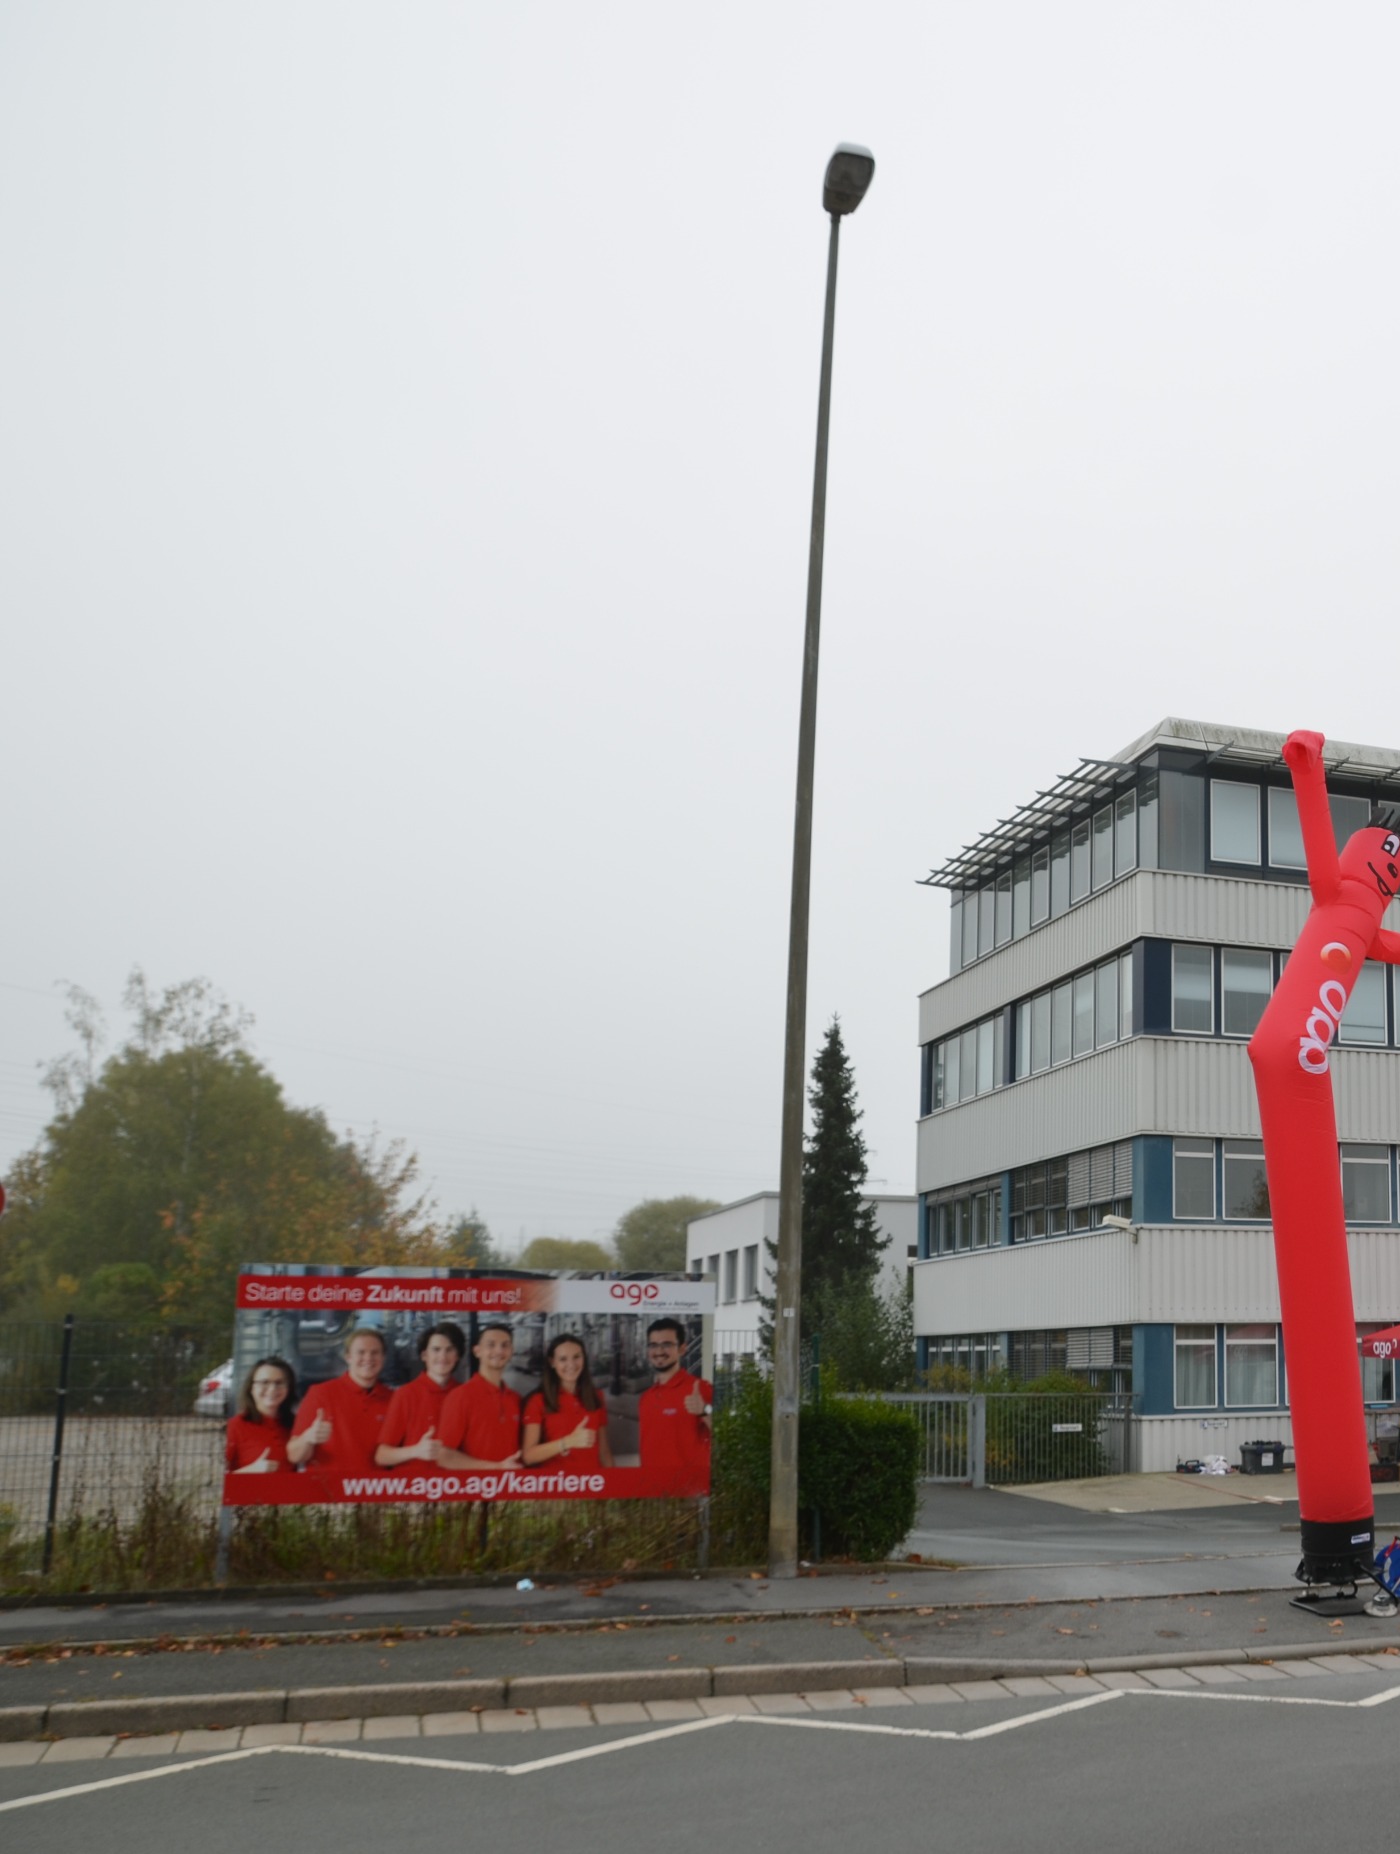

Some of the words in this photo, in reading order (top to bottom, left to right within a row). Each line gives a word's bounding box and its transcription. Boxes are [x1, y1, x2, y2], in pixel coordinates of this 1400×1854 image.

[1298, 980, 1347, 1074] ago
[245, 1284, 304, 1301] Starte
[307, 1284, 364, 1302] deine
[367, 1285, 444, 1303] Zukunft
[447, 1286, 479, 1303] mit
[481, 1286, 521, 1304] uns!
[610, 1284, 659, 1306] ago
[1373, 1341, 1391, 1358] ago
[343, 1474, 605, 1498] www.ago.ag/karriere
